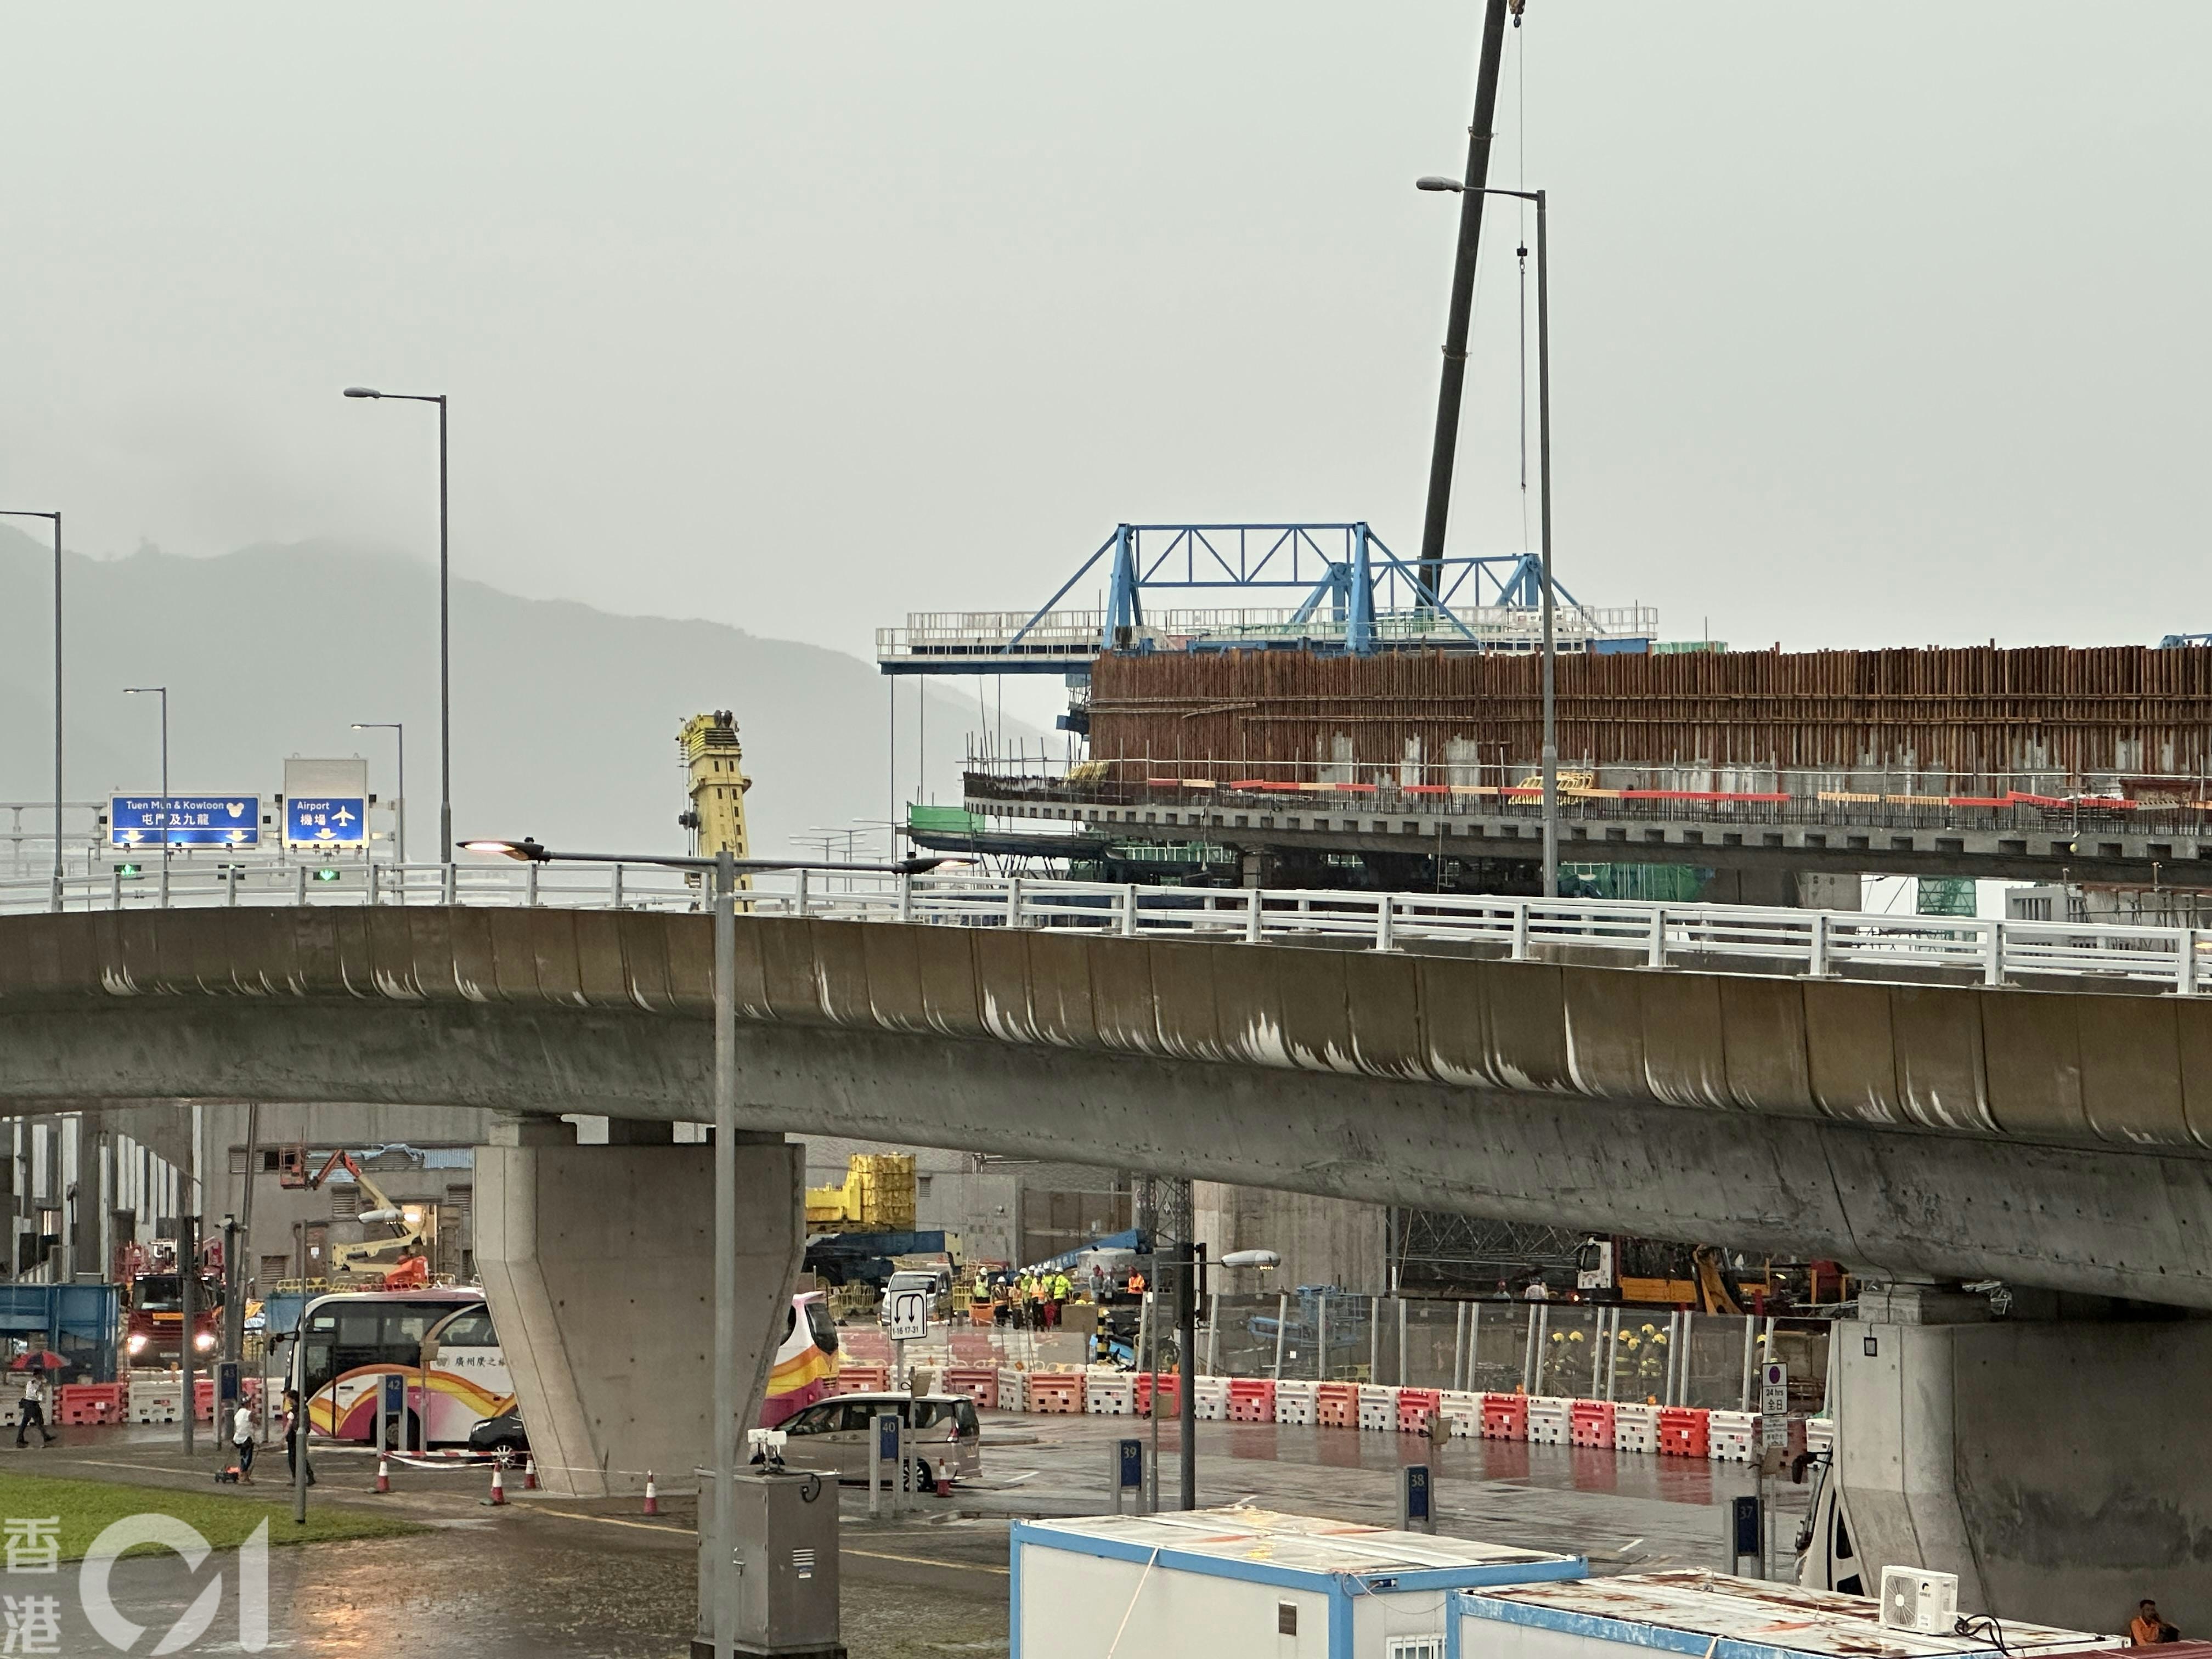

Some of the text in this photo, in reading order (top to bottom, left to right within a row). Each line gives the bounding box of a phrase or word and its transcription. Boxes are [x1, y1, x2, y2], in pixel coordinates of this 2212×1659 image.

[126, 801, 149, 809] Tuen
[174, 801, 180, 809] &
[183, 801, 224, 809] Kowloon
[297, 801, 330, 811] Airport
[300, 814, 326, 826] 機場
[387, 1380, 400, 1390] 42
[1768, 1399, 1782, 1410] 全日
[883, 1422, 895, 1432] 40
[1123, 1446, 1136, 1458] 39
[1411, 1474, 1424, 1487] 38
[1739, 1506, 1753, 1519] 37
